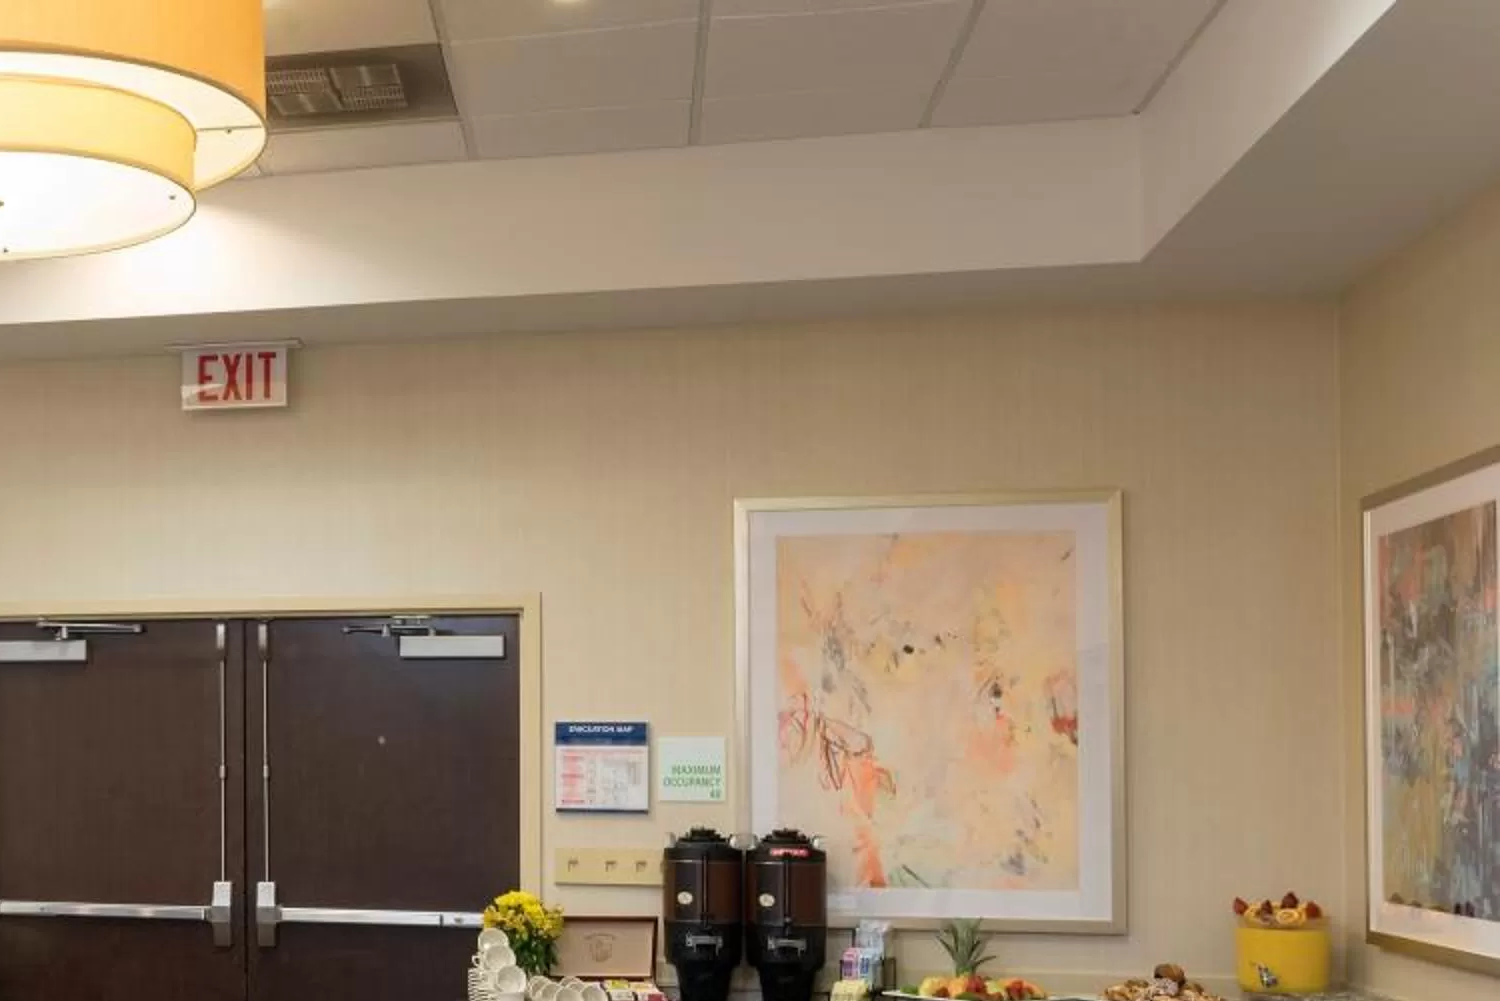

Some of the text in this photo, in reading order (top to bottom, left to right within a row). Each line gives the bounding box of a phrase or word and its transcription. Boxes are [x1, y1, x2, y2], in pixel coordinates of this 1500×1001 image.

[197, 351, 277, 403] EXIT
[671, 764, 721, 775] MAXIMUM
[663, 776, 722, 787] OCCUPANCY
